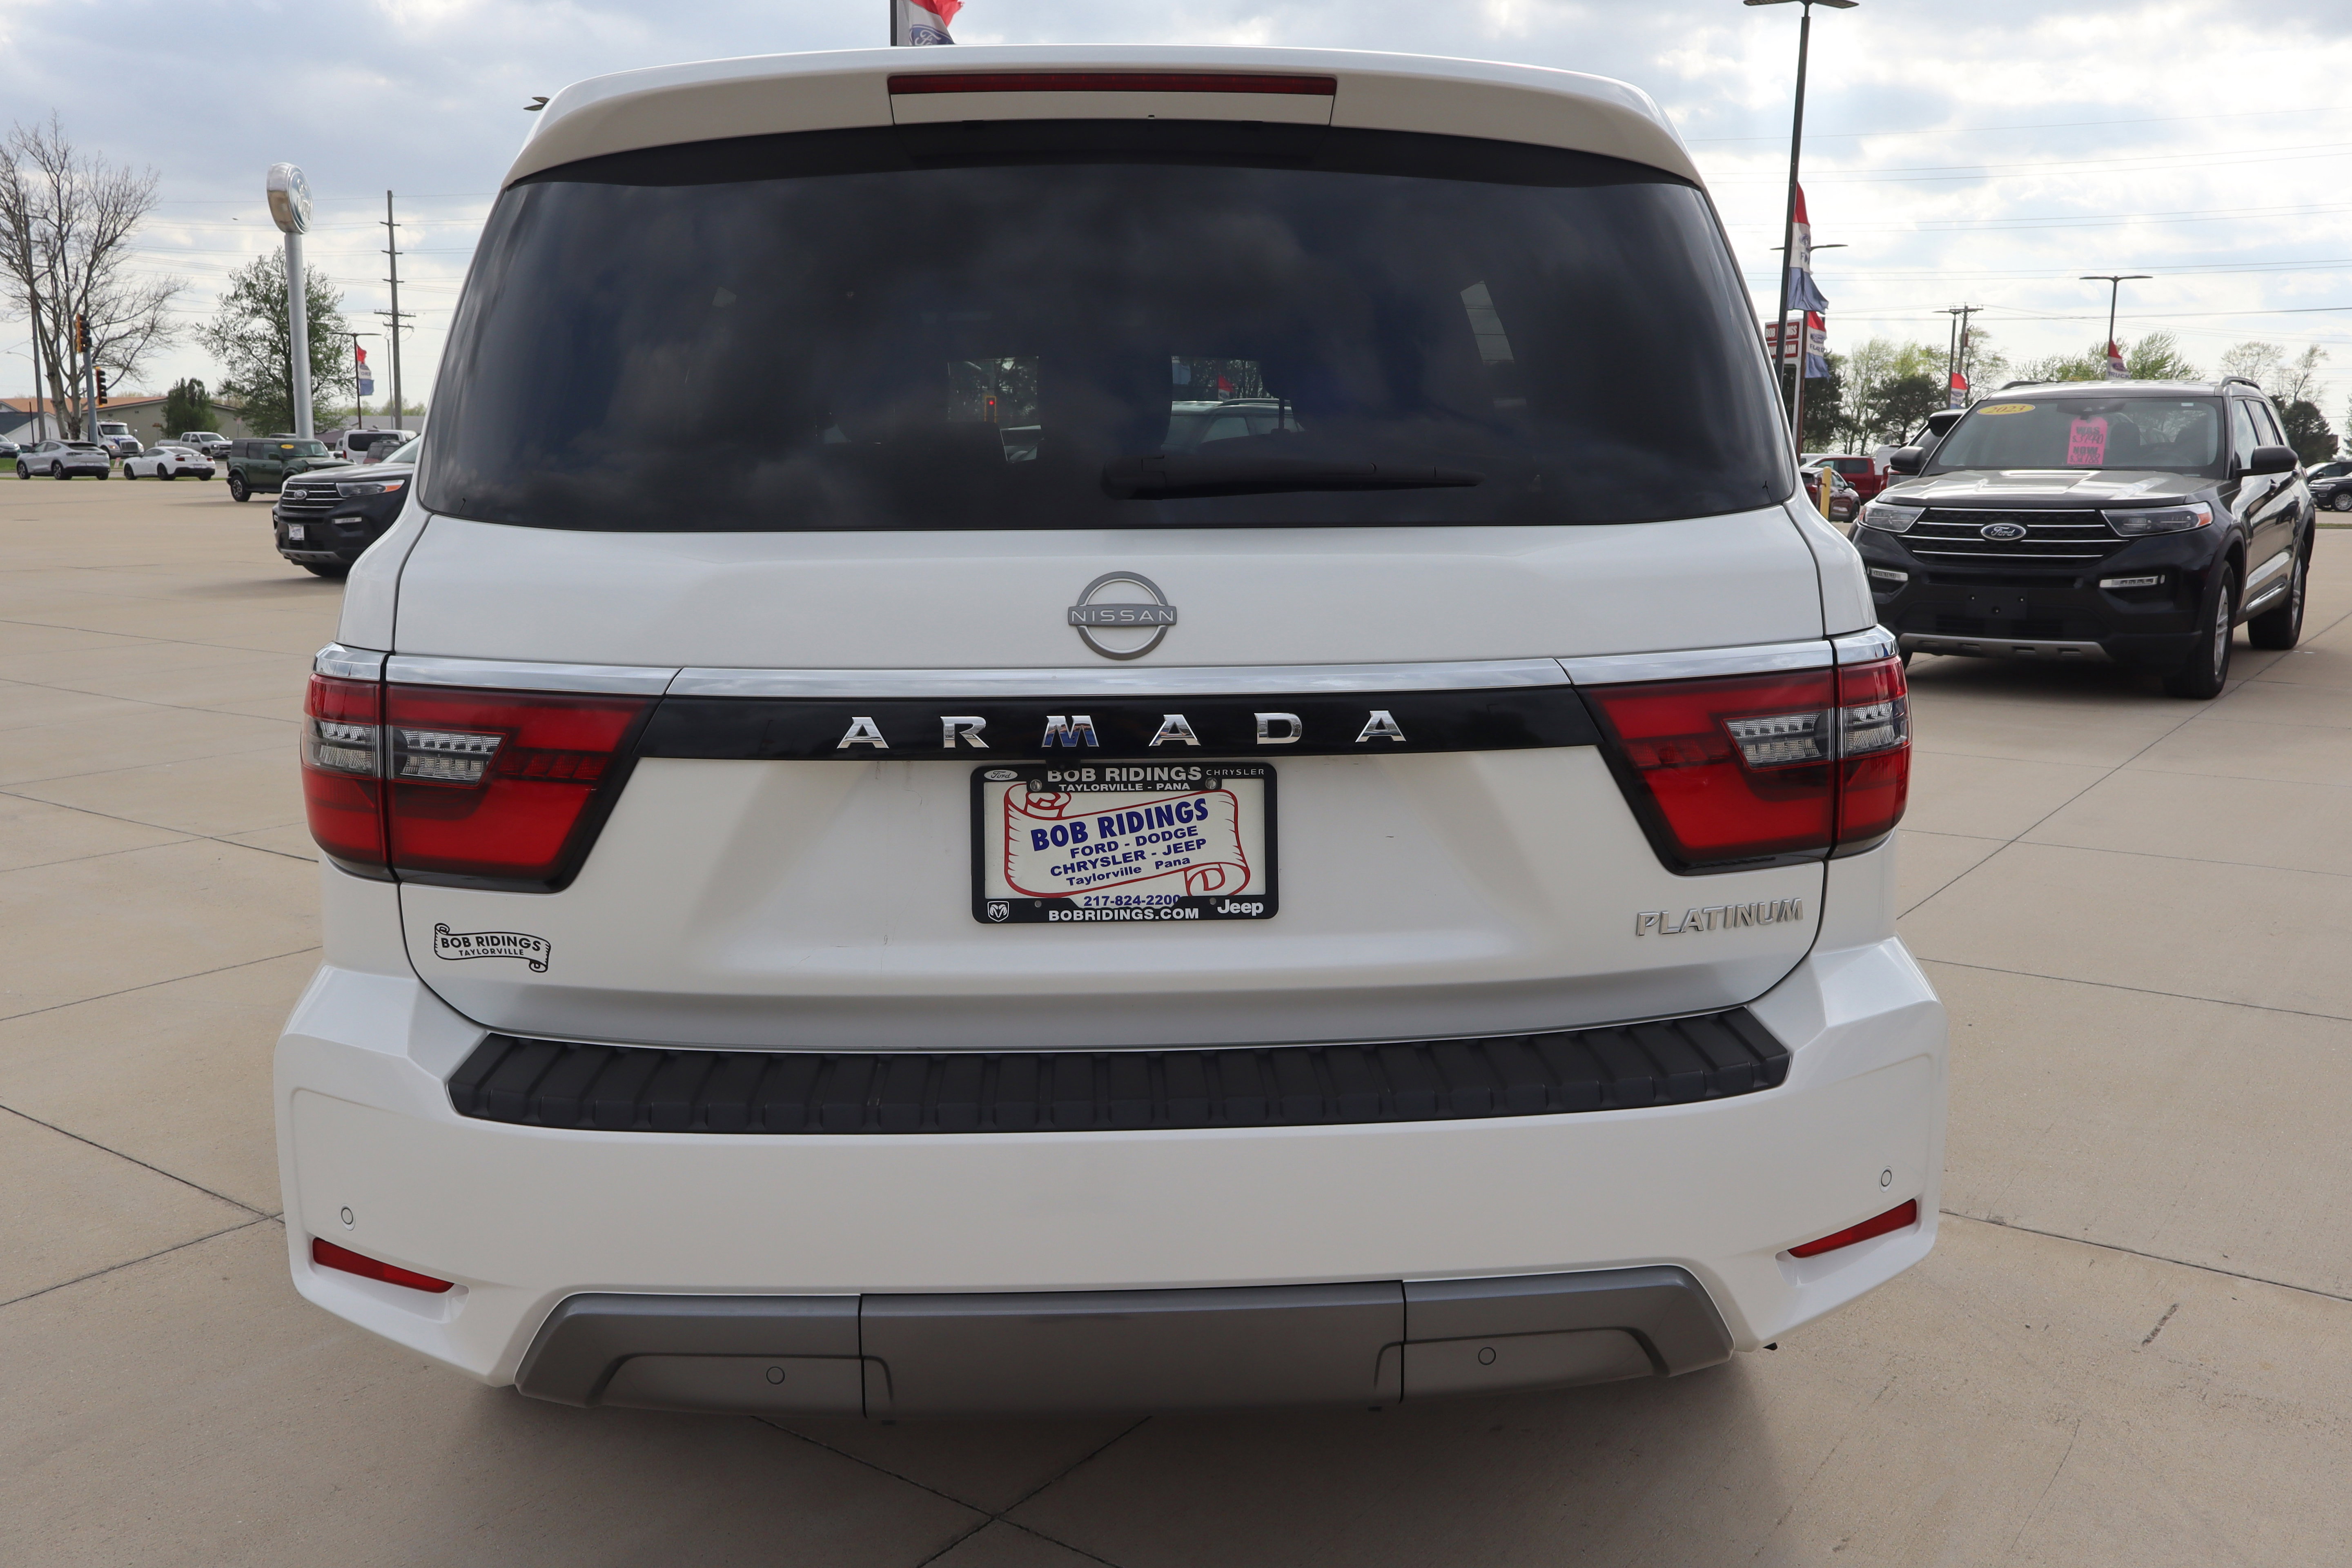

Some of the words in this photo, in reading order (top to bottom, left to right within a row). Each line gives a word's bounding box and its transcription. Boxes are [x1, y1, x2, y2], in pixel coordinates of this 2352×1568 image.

[1766, 328, 1775, 337] BOB
[1986, 405, 2026, 413] 2023
[2076, 426, 2100, 435] WAS
[2073, 446, 2098, 456] NOW
[1991, 526, 2016, 536] Ford
[1071, 610, 1174, 621] NISSAN
[837, 710, 1406, 749] ARMADA
[991, 771, 1011, 779] Ford
[1047, 768, 1096, 782] BOB
[1105, 766, 1202, 781] RIDINGS
[1059, 783, 1143, 791] TAYLORVILLE
[1031, 822, 1088, 851] BOB
[1097, 798, 1208, 839] RIDINGS
[1070, 841, 1119, 858] FORD
[1135, 826, 1198, 847] DODGE
[1050, 850, 1147, 877] CHRYSLER
[1162, 838, 1207, 856] JEEP
[1066, 866, 1142, 886] Taylorville
[1155, 858, 1190, 869] Pana
[1084, 895, 1180, 907] 217-824-2200
[1217, 899, 1264, 916] Jeep
[1049, 908, 1199, 921] BOBRIDINGS.COM
[1636, 898, 1804, 936] PLATINUM
[441, 937, 471, 948] BOB
[475, 935, 541, 951] RIDINGS
